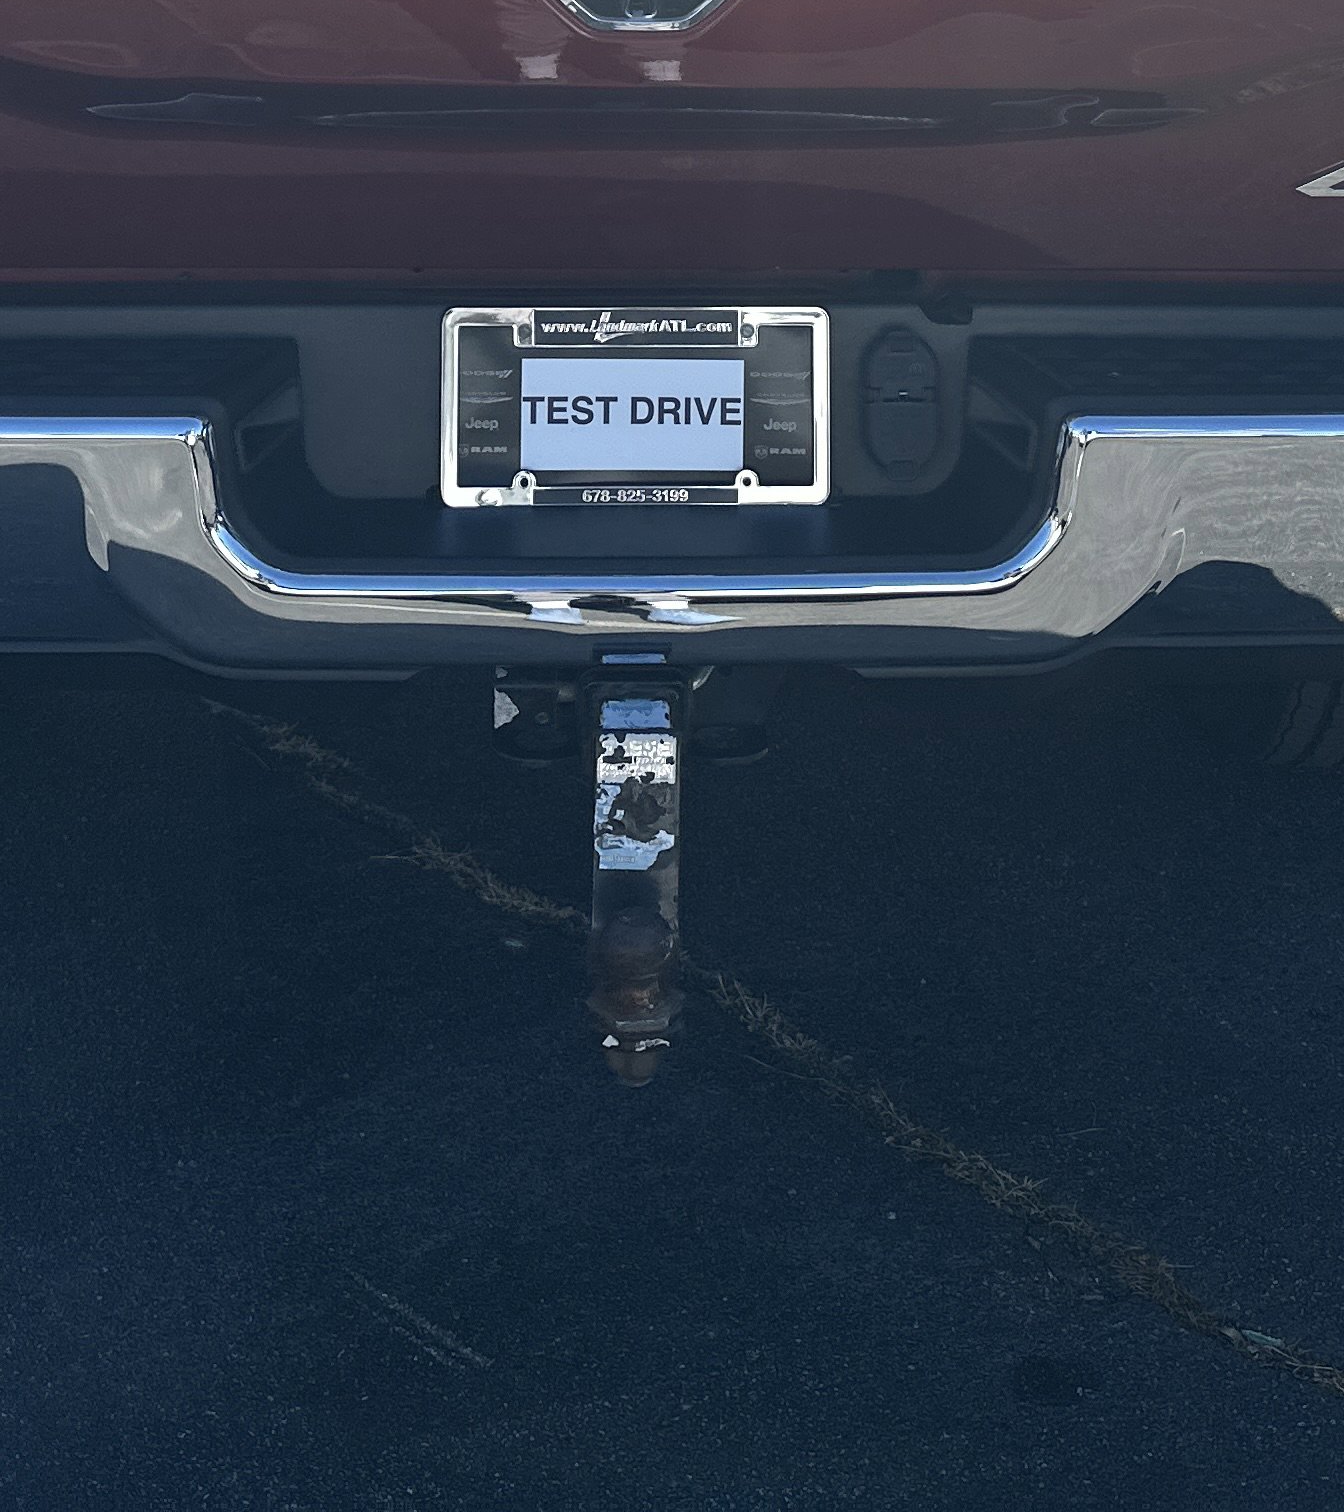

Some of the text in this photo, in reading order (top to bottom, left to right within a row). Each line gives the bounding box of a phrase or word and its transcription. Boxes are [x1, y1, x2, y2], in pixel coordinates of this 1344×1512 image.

[523, 396, 742, 425] TEST DRIVE
[464, 417, 499, 431] Jeep
[763, 418, 797, 433] Jeep
[582, 489, 689, 502] 678-825-3199
